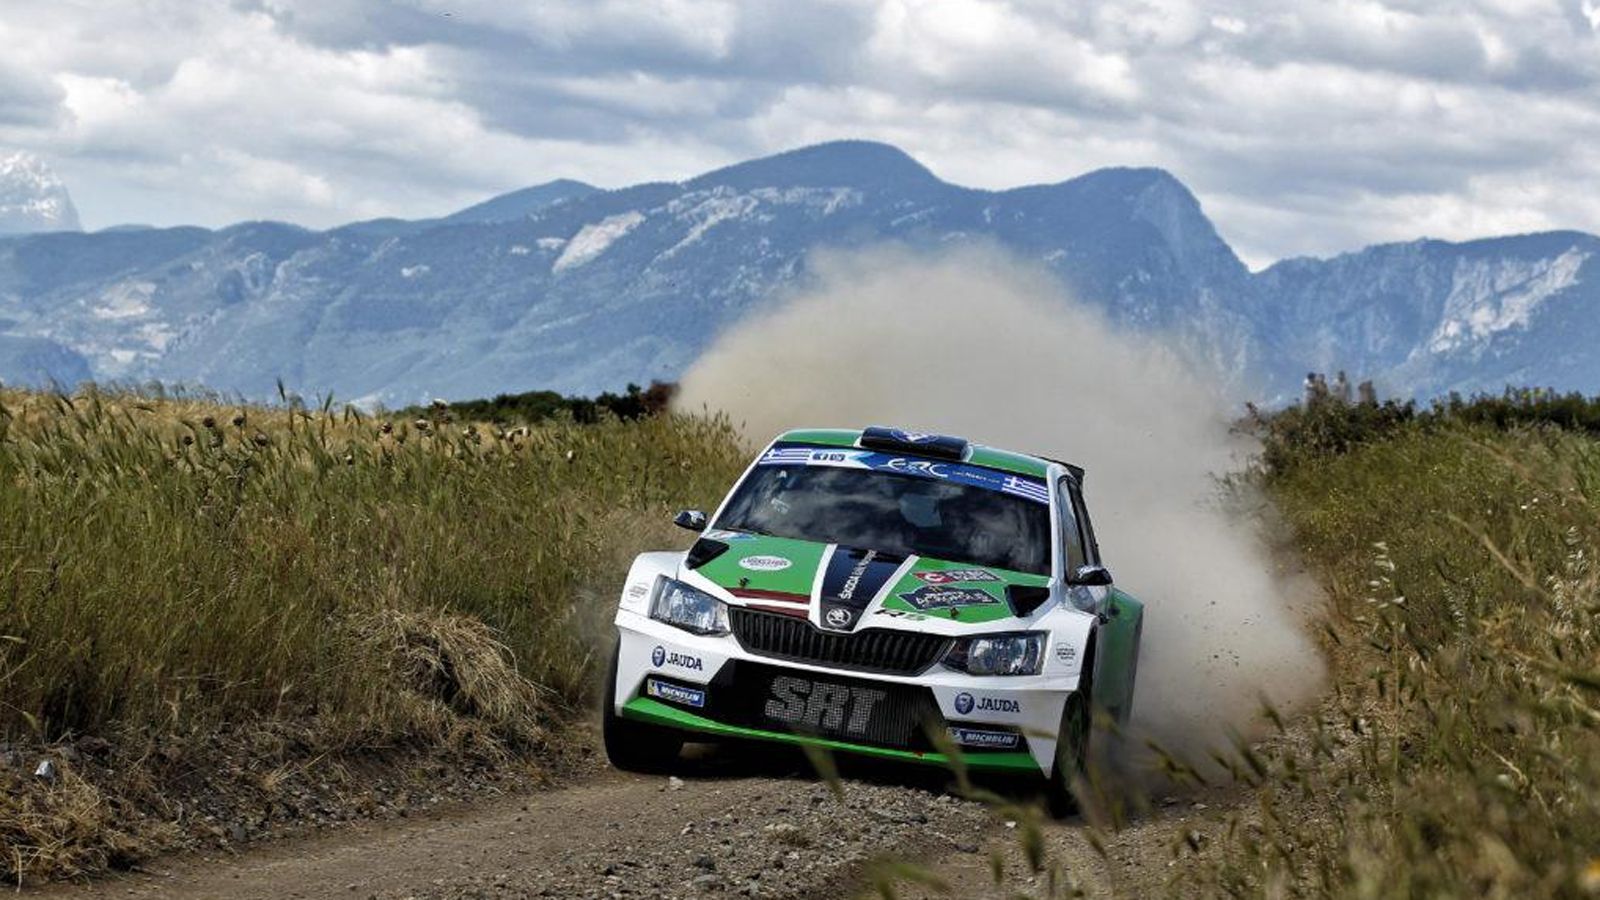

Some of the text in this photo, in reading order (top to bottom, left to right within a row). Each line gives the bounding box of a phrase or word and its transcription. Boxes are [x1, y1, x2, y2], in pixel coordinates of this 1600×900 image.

[666, 652, 703, 671] JAUDA
[660, 685, 700, 701] MICHELIN
[765, 676, 887, 733] SRT
[976, 698, 1020, 713] JAUDA
[965, 733, 1015, 745] MICHELIN
